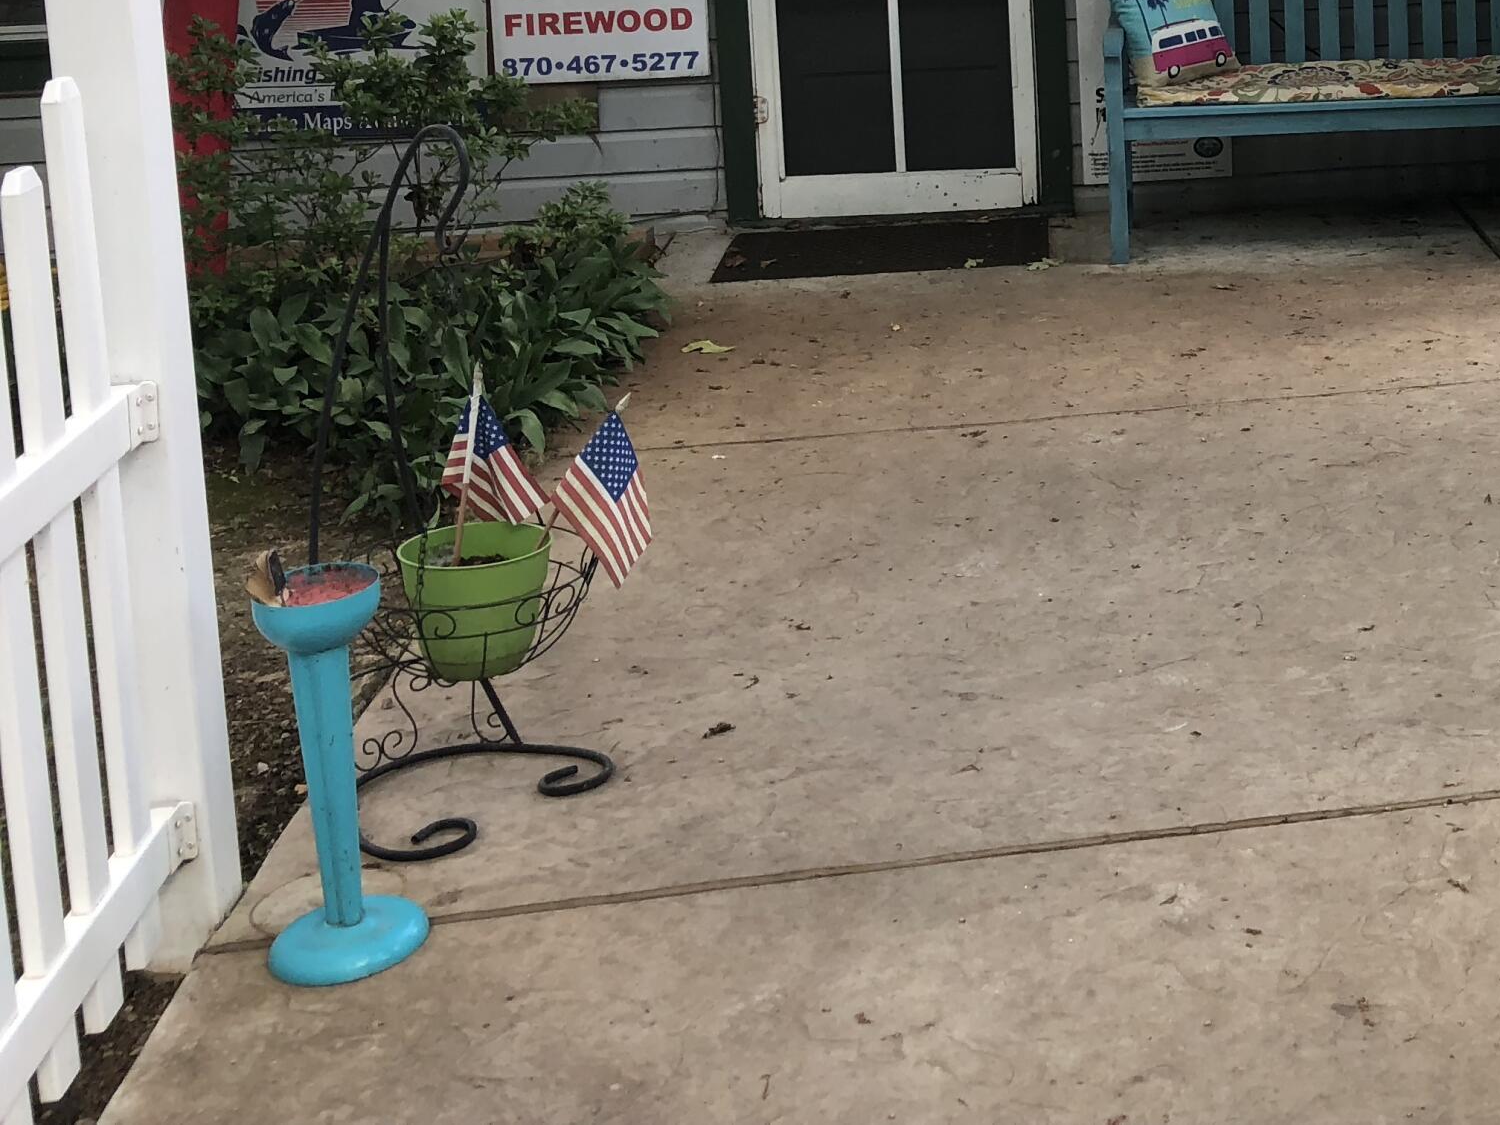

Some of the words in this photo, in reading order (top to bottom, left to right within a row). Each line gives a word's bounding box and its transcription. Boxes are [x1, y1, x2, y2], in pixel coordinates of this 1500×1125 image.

[504, 7, 693, 37] FIREWOOD
[254, 66, 317, 84] ishing
[249, 89, 325, 104] America's
[304, 113, 353, 136] Maps
